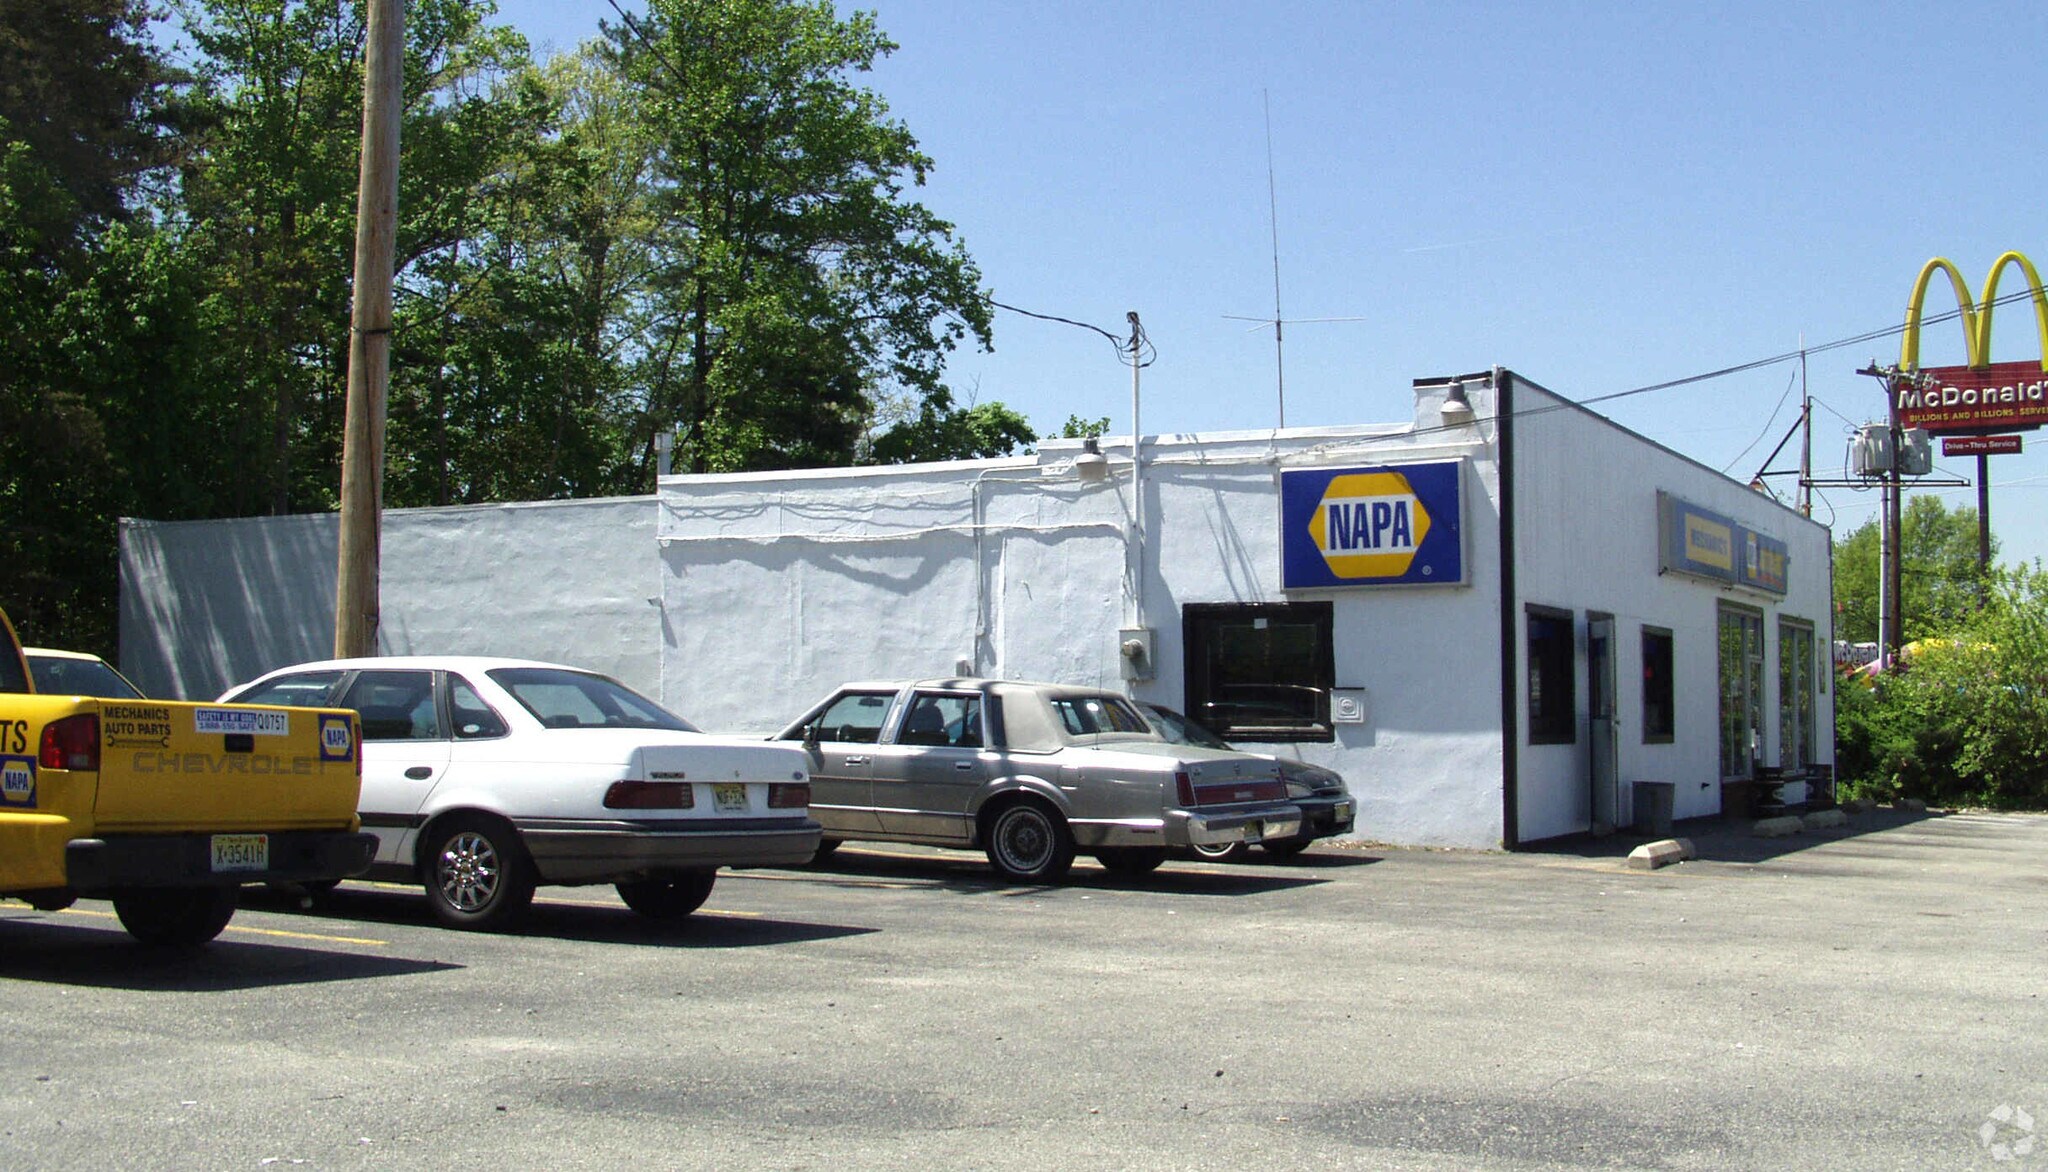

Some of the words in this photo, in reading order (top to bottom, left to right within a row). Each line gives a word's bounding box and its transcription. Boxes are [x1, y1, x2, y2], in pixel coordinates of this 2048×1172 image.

[1909, 413, 1949, 423] BILLIONS
[1952, 411, 1971, 420] AND
[1974, 409, 2014, 419] BILLIONS
[1988, 440, 2017, 449] Service
[1328, 500, 1412, 550] NAPA
[104, 706, 170, 721] MECHANICS
[257, 713, 286, 731] Q0757
[0, 719, 28, 754] TS
[104, 722, 135, 735] AUTO
[137, 723, 171, 736] PARTS
[325, 727, 347, 747] NAPA
[132, 751, 327, 776] CHEVROLET
[5, 769, 29, 792] NAPA
